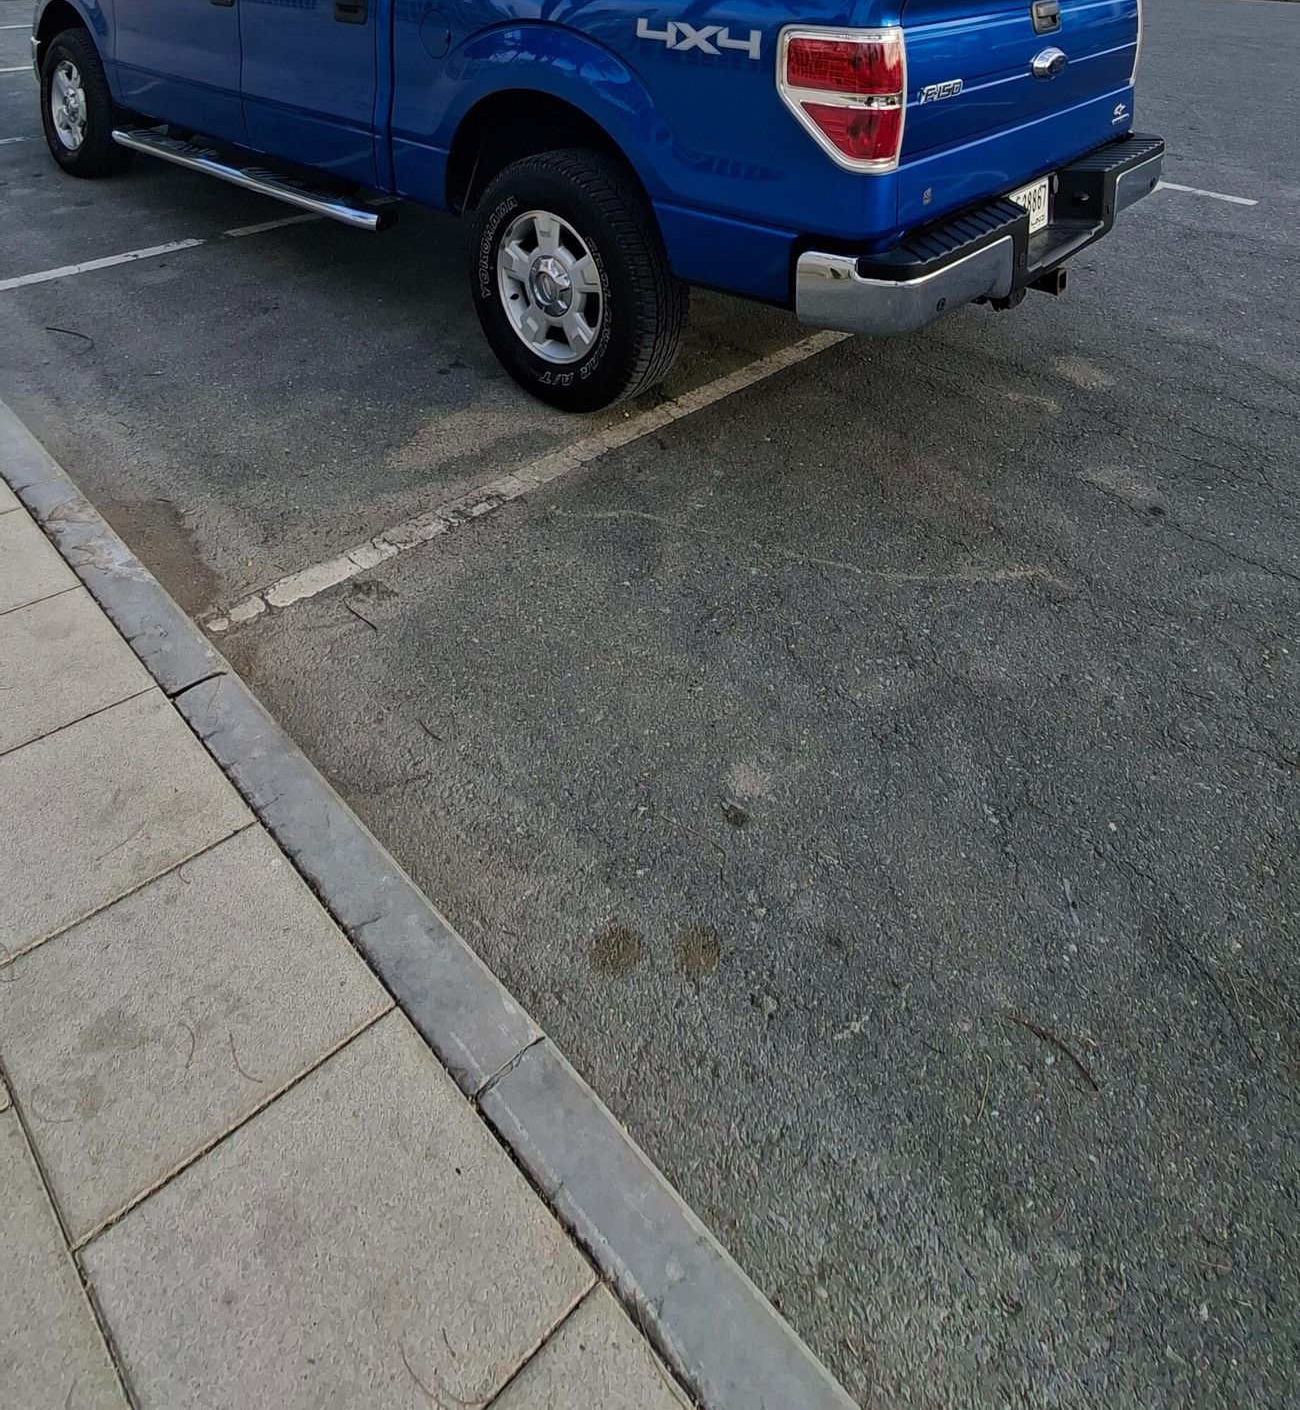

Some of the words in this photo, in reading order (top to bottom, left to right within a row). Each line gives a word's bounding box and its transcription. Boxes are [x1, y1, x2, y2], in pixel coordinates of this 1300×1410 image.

[636, 17, 762, 60] 4X4
[479, 195, 519, 299] YOKOHAMA
[538, 371, 574, 387] A/T
